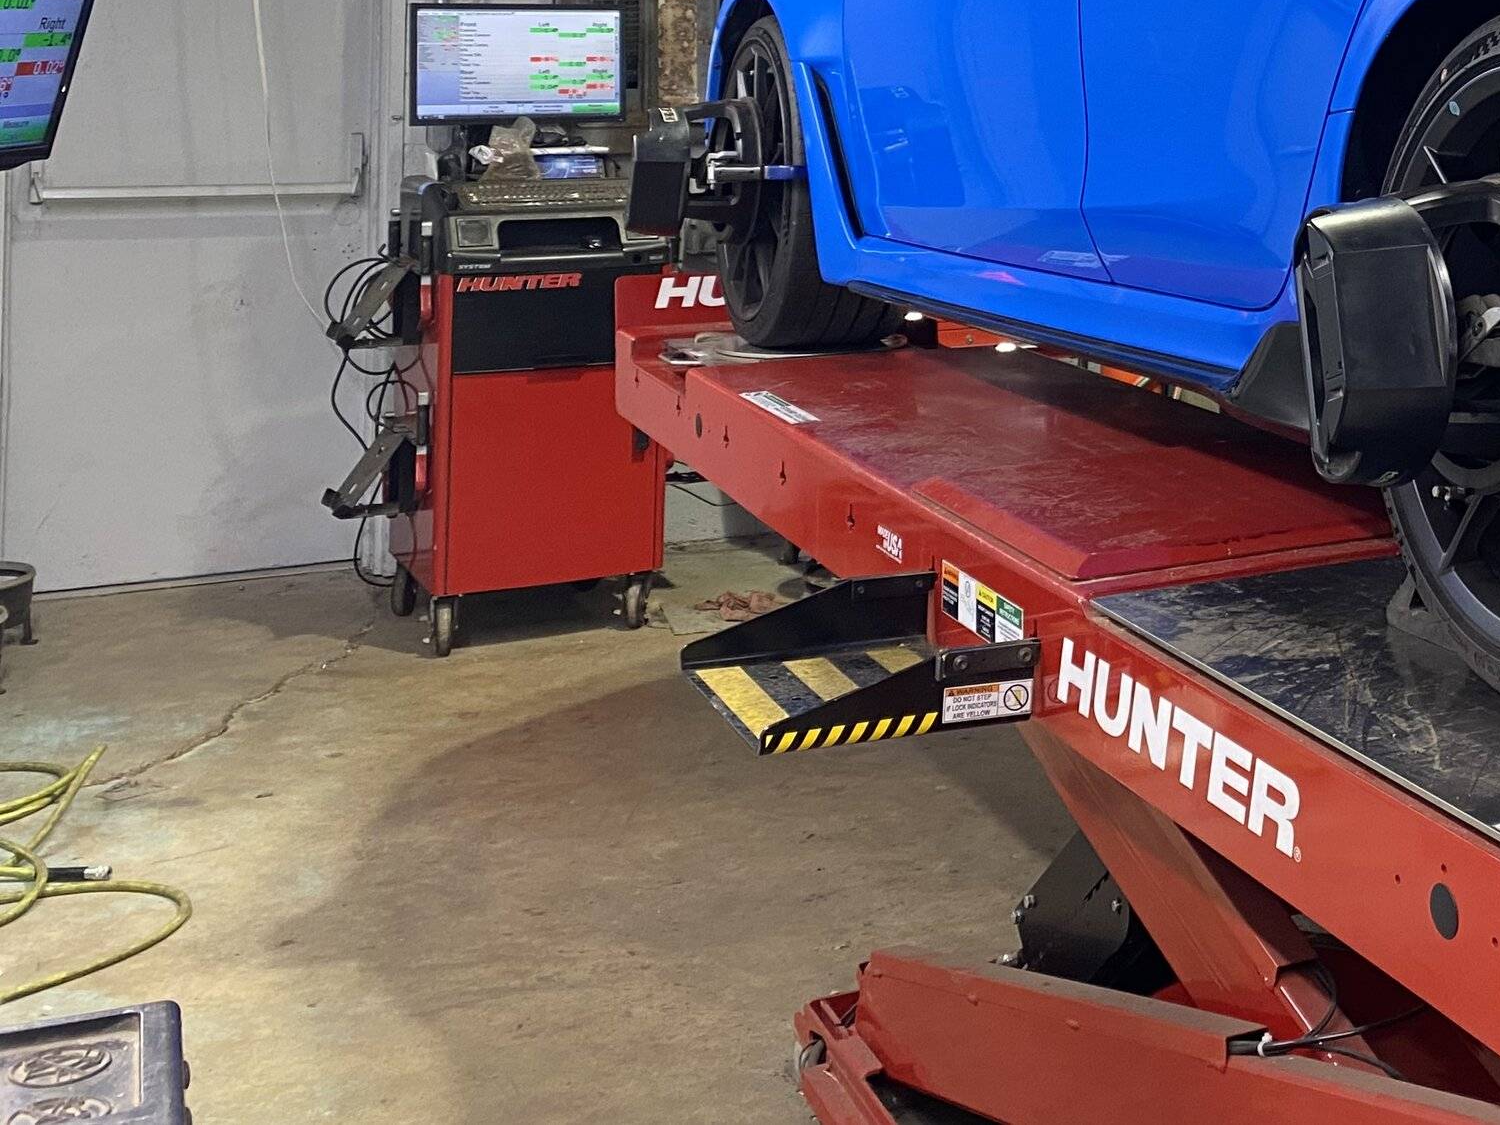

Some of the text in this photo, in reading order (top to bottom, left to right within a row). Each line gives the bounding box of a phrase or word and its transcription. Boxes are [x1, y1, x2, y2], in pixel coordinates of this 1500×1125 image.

[39, 17, 67, 33] Right
[456, 273, 582, 293] HUNTER
[887, 532, 902, 559] USA
[956, 685, 993, 695] WARNING
[967, 701, 996, 709] INDICATORS
[966, 709, 990, 718] YELLOW
[1057, 637, 1300, 858] HUNTER
